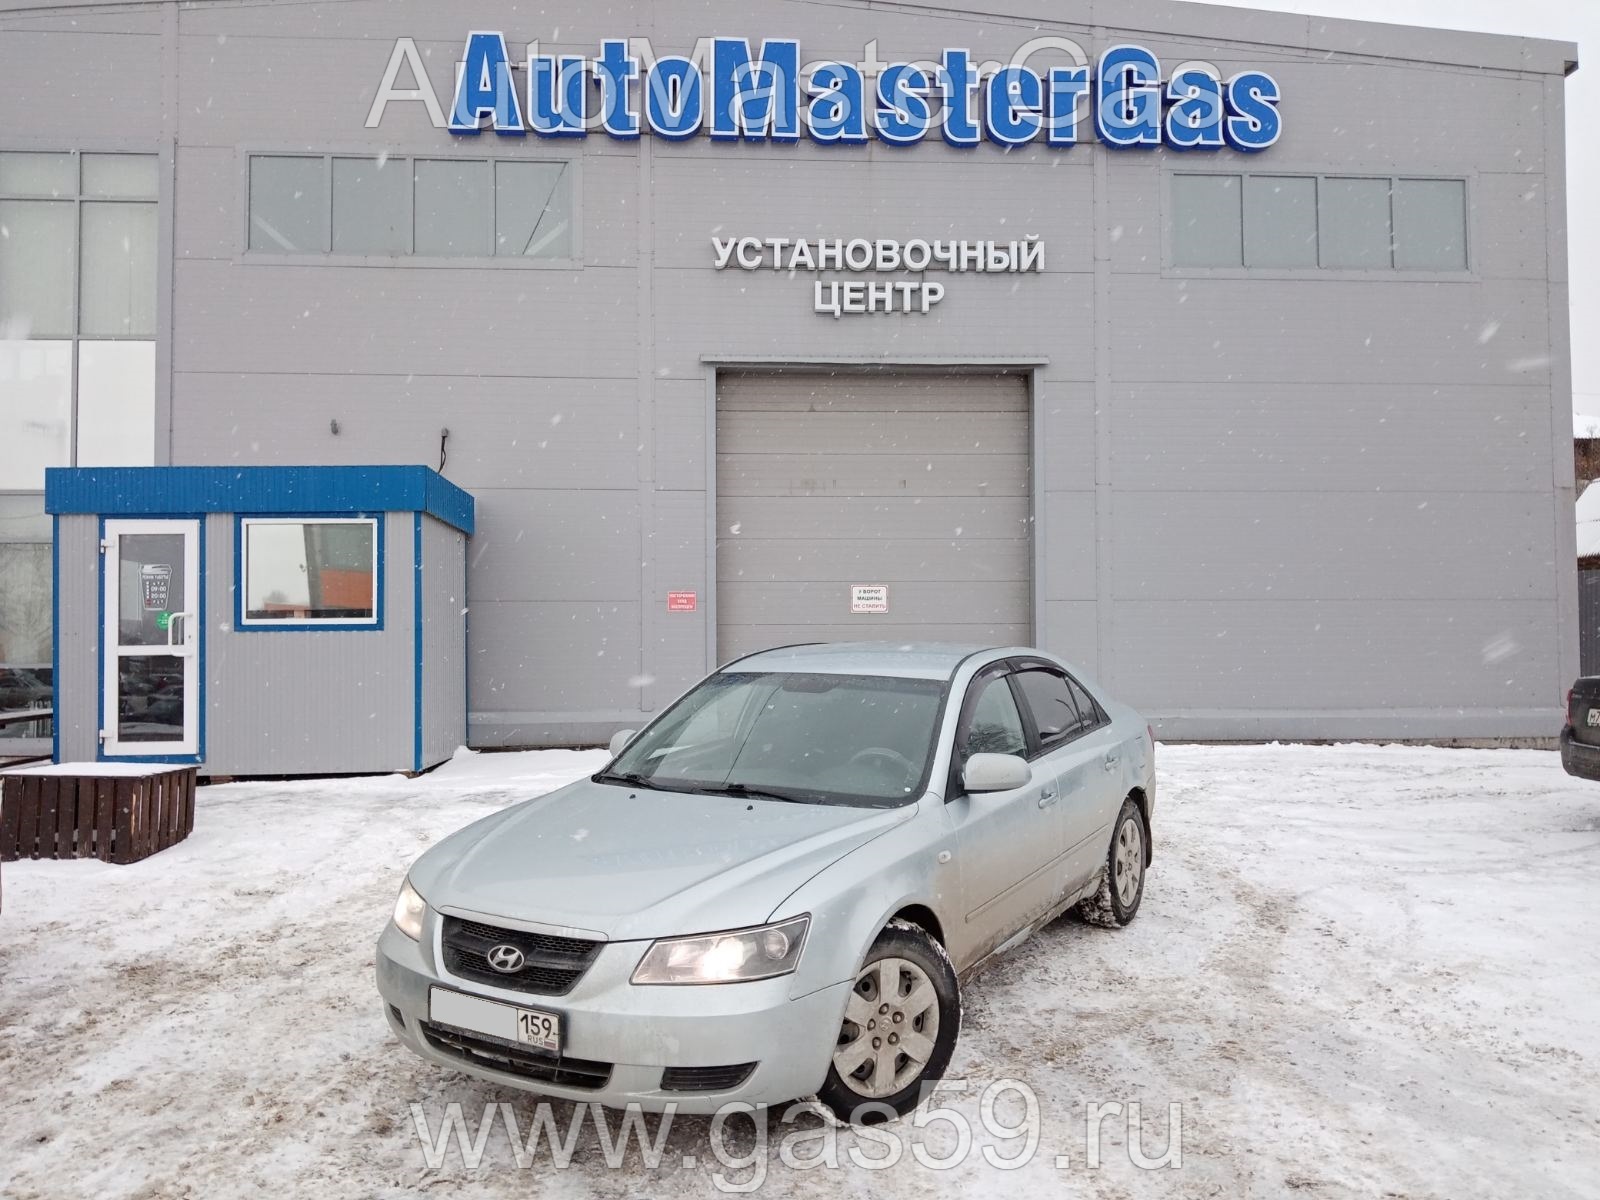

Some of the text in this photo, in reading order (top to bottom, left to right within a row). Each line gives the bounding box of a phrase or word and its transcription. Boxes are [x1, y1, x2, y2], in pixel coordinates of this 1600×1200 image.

[448, 30, 1282, 153] AutoMasterGas
[711, 233, 1046, 272] УСТАНОВОЧНЫЙ
[814, 280, 945, 318] ЦЕНТР
[520, 1013, 552, 1040] 159
[527, 1034, 544, 1046] RUS
